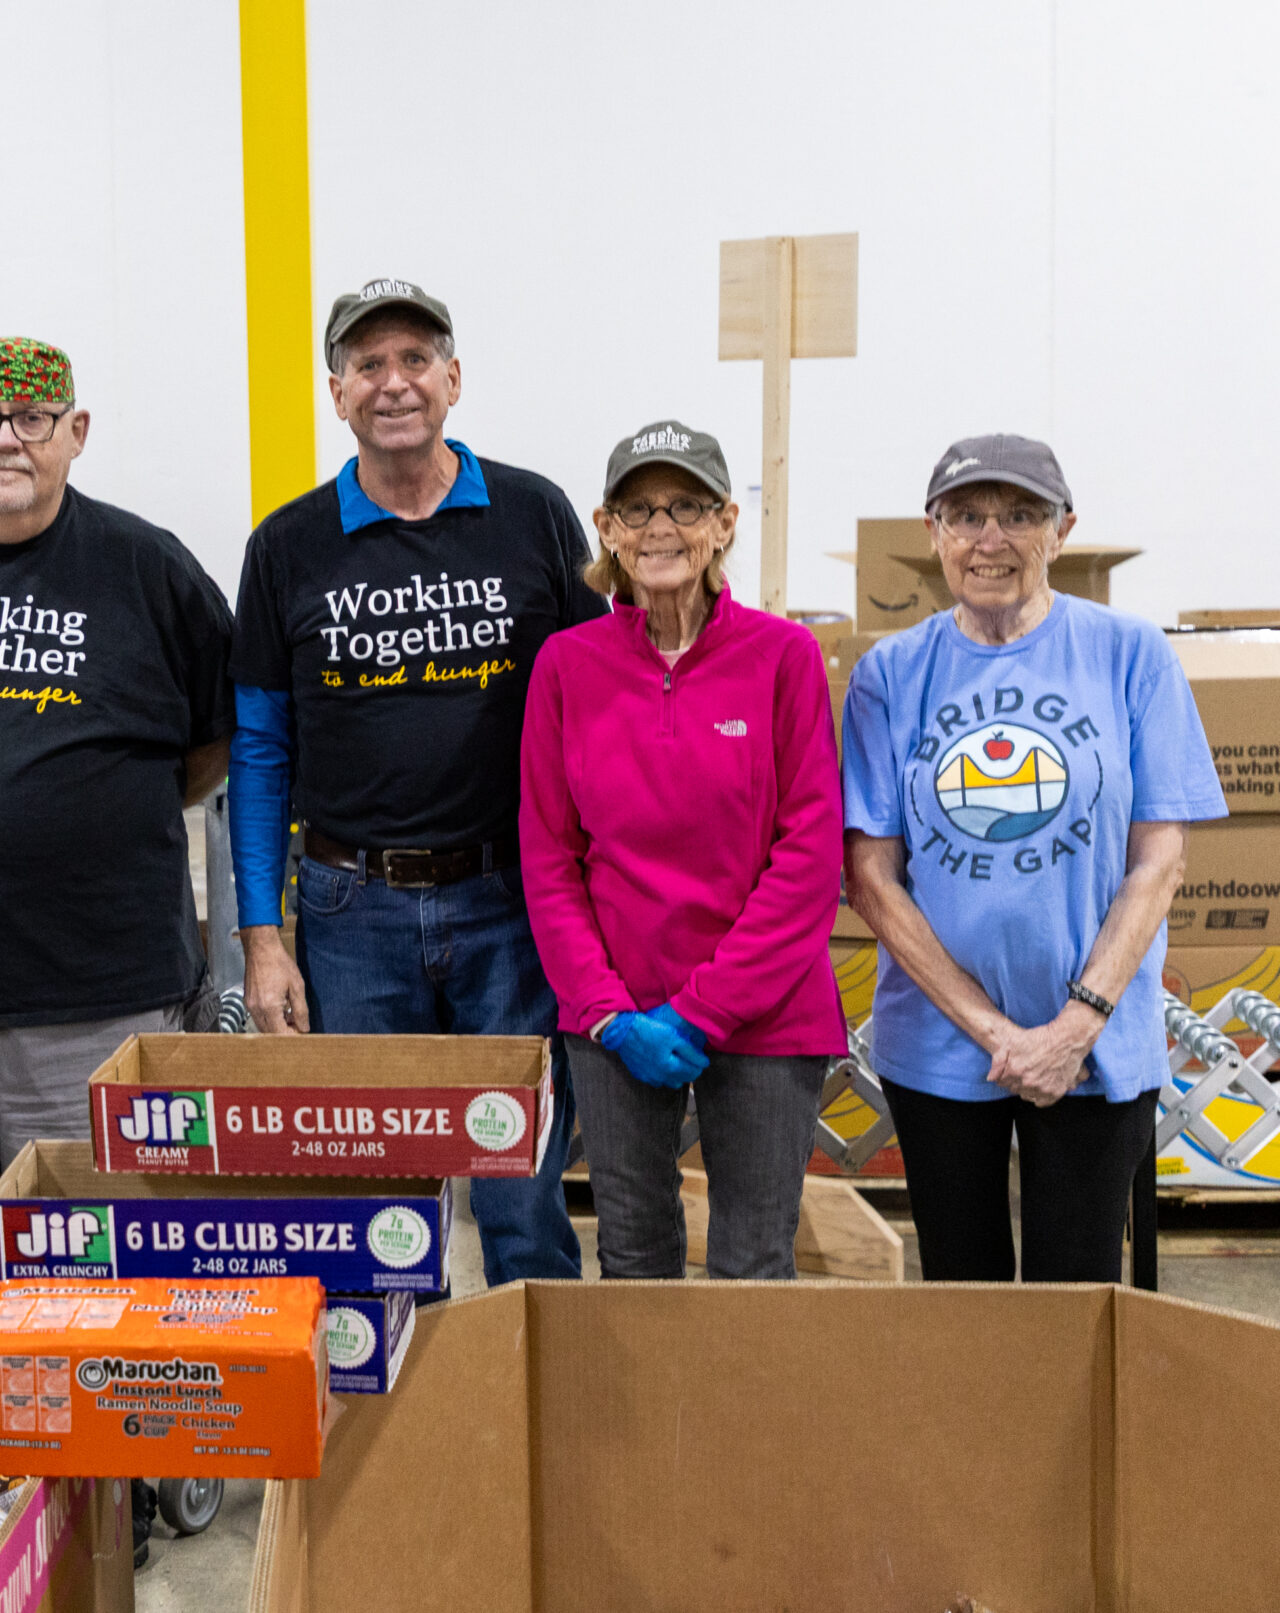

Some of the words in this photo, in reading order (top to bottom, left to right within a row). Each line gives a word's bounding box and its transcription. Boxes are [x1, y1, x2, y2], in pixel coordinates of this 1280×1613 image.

[325, 572, 507, 623] Working
[320, 612, 513, 667] Together
[322, 670, 344, 688] to
[359, 665, 408, 687] end
[422, 658, 516, 689] hunger
[914, 686, 1100, 763] BRIDGE
[1212, 746, 1243, 760] you
[1248, 746, 1280, 757] can
[1237, 761, 1280, 775] what
[1221, 779, 1274, 796] aking
[920, 826, 994, 880] THE
[1014, 818, 1092, 873] GAP
[484, 1103, 497, 1118] 7g
[120, 1098, 200, 1141] Jif
[226, 1106, 243, 1133] 6
[252, 1106, 283, 1134] LB
[294, 1107, 375, 1135] CLUB
[382, 1108, 453, 1135] SIZE
[473, 1117, 507, 1131] PROTEIN
[136, 1147, 189, 1159] CREAMY
[292, 1141, 323, 1156] 2-48
[328, 1142, 347, 1157] OZ
[352, 1142, 386, 1157] JARS
[391, 1214, 403, 1229] 7g
[16, 1212, 99, 1257] Jif
[126, 1221, 143, 1251] 6
[152, 1222, 185, 1251] LB
[195, 1222, 278, 1251] CLUB
[284, 1223, 357, 1251] SIZE
[378, 1229, 413, 1242] PROTEIN
[13, 1265, 49, 1277] EXTRA
[53, 1265, 108, 1277] CRUNCHY
[193, 1257, 224, 1273] 2-48
[229, 1258, 249, 1274] OZ
[253, 1258, 287, 1274] JARS
[103, 1357, 219, 1382] Maruchan
[113, 1383, 171, 1398] Instant
[176, 1385, 222, 1399] Lunch
[96, 1396, 146, 1410] Ramen
[149, 1398, 202, 1412] Noodle
[205, 1401, 242, 1417] Soup
[123, 1414, 141, 1437] 6
[143, 1414, 177, 1426] PACK
[182, 1417, 235, 1430] Chicken
[143, 1425, 169, 1438] CUP
